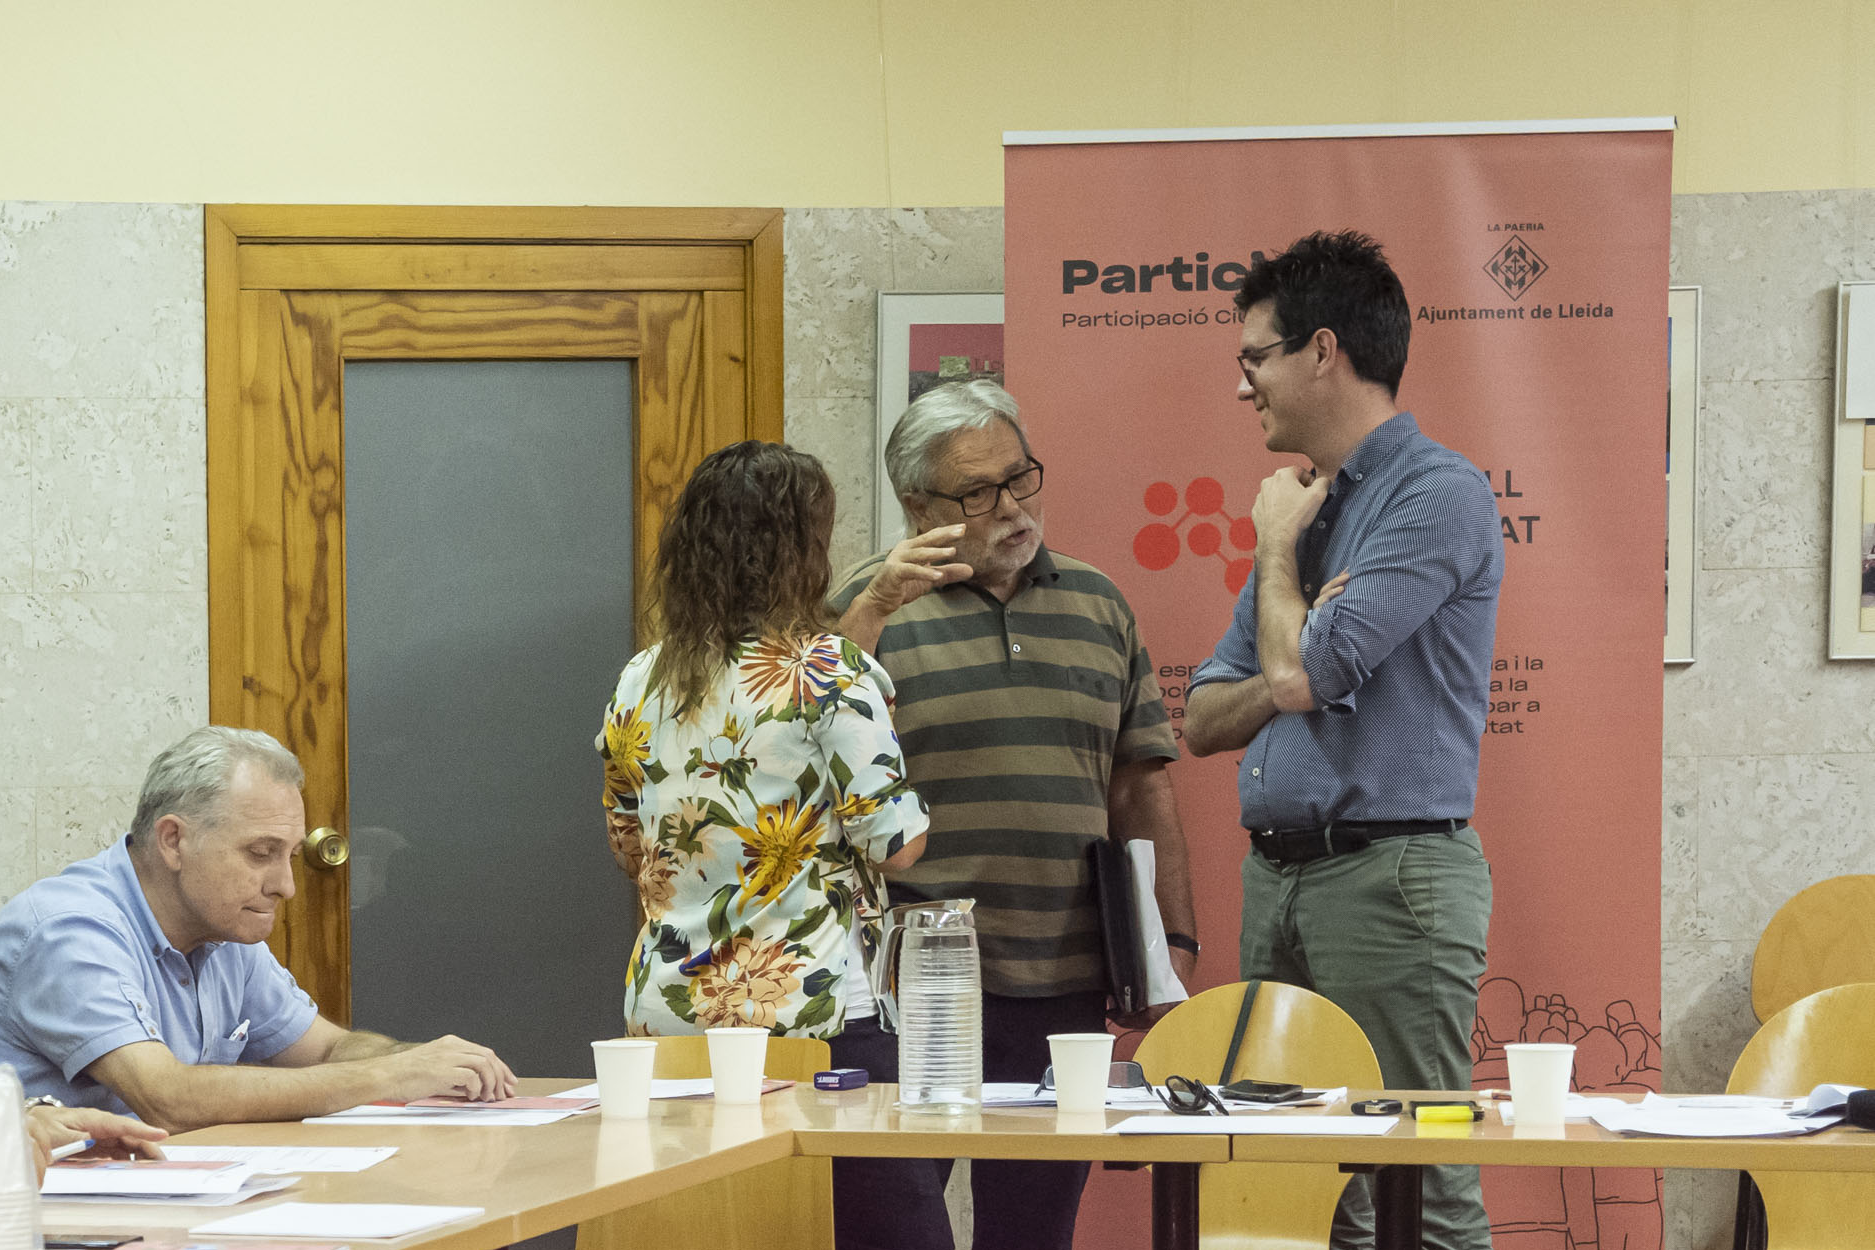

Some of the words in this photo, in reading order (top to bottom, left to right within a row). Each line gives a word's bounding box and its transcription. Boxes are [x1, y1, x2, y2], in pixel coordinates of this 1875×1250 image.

[1487, 223, 1501, 232] LA
[1504, 222, 1545, 232] PAERIA
[1062, 306, 1209, 330] Participació
[1417, 305, 1525, 324] Ajuntament
[1530, 303, 1553, 319] de
[1558, 302, 1614, 319] Lleida
[1525, 655, 1544, 671] la
[1509, 677, 1528, 692] la
[1526, 700, 1541, 713] a
